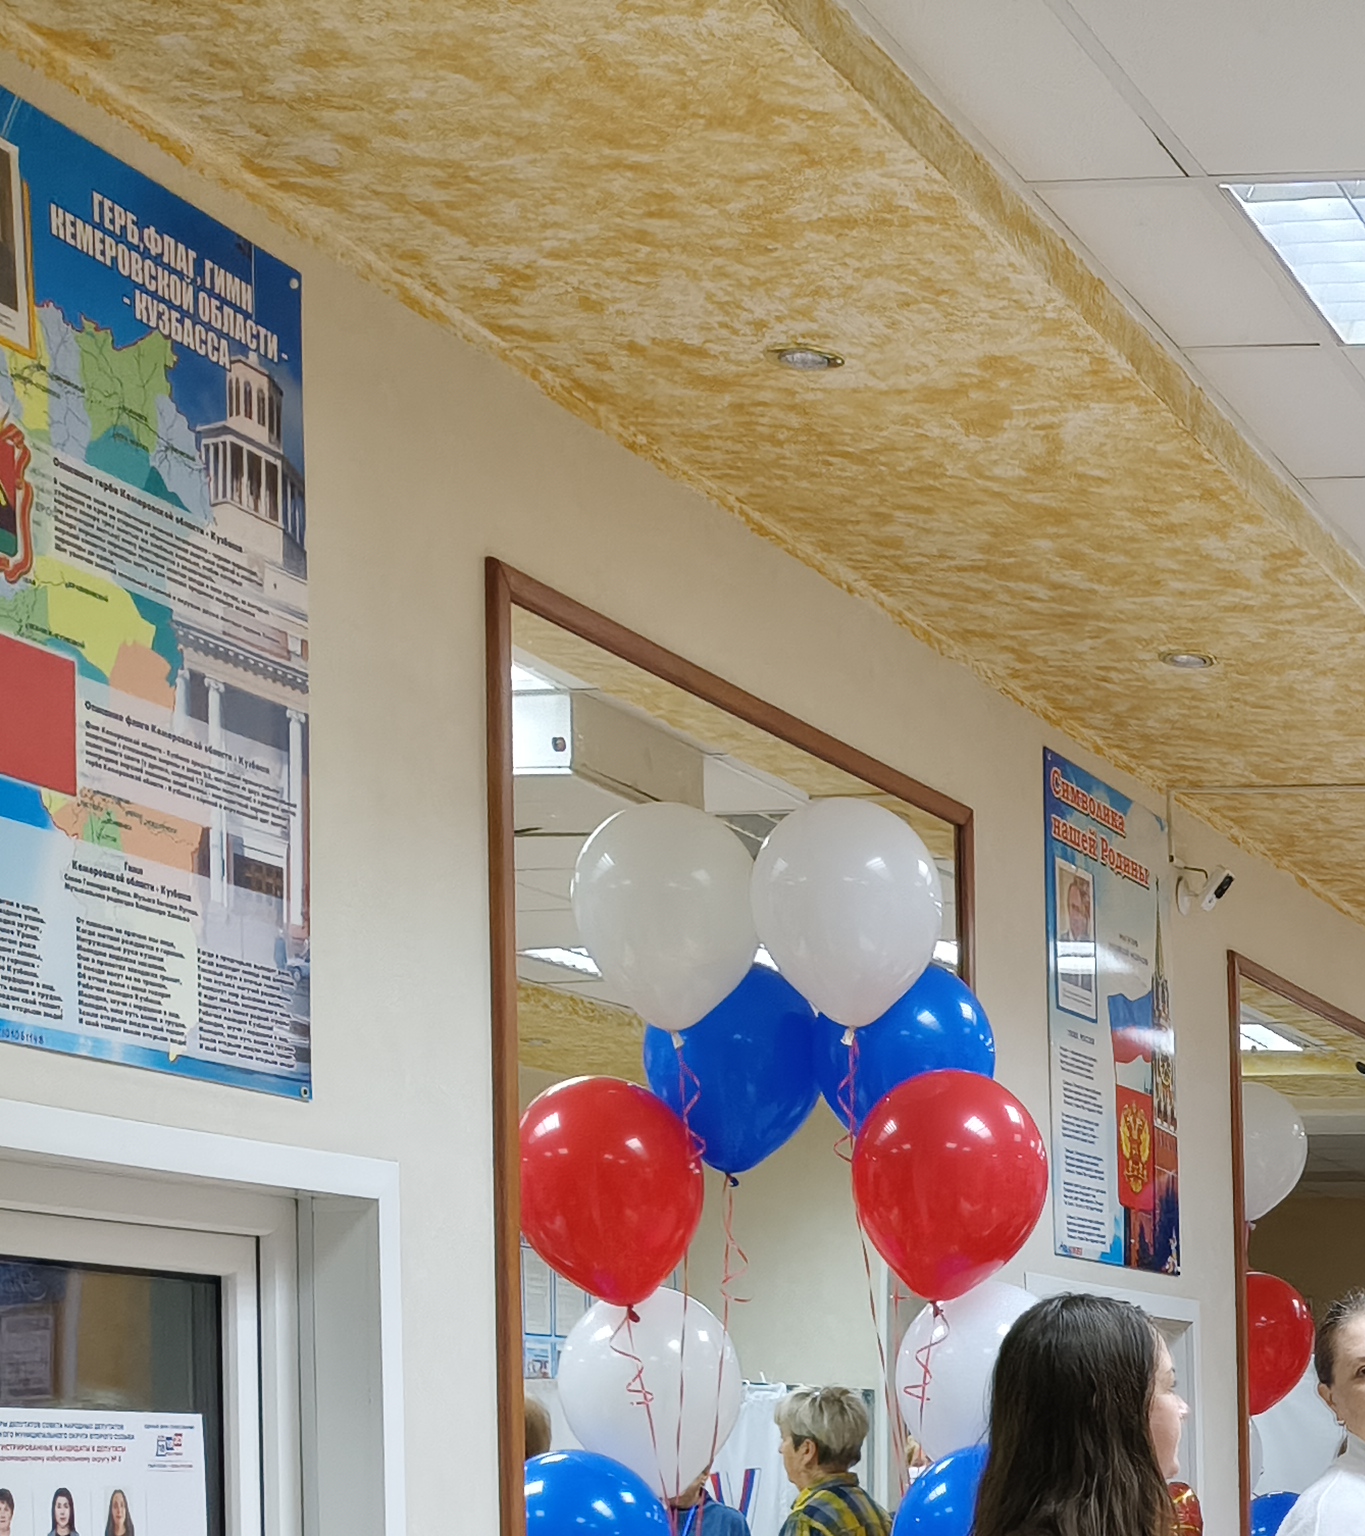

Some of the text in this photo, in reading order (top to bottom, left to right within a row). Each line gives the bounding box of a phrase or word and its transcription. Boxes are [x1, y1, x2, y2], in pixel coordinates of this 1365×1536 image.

[49, 203, 194, 315] КЕМЕРОВСКОЙ
[198, 291, 279, 363] ОБЛАСТИ
[204, 259, 253, 315] ГИМН
[134, 289, 232, 372] КУЗБАССА
[1051, 768, 1126, 837] Символика
[1051, 814, 1150, 889] нашей Родины
